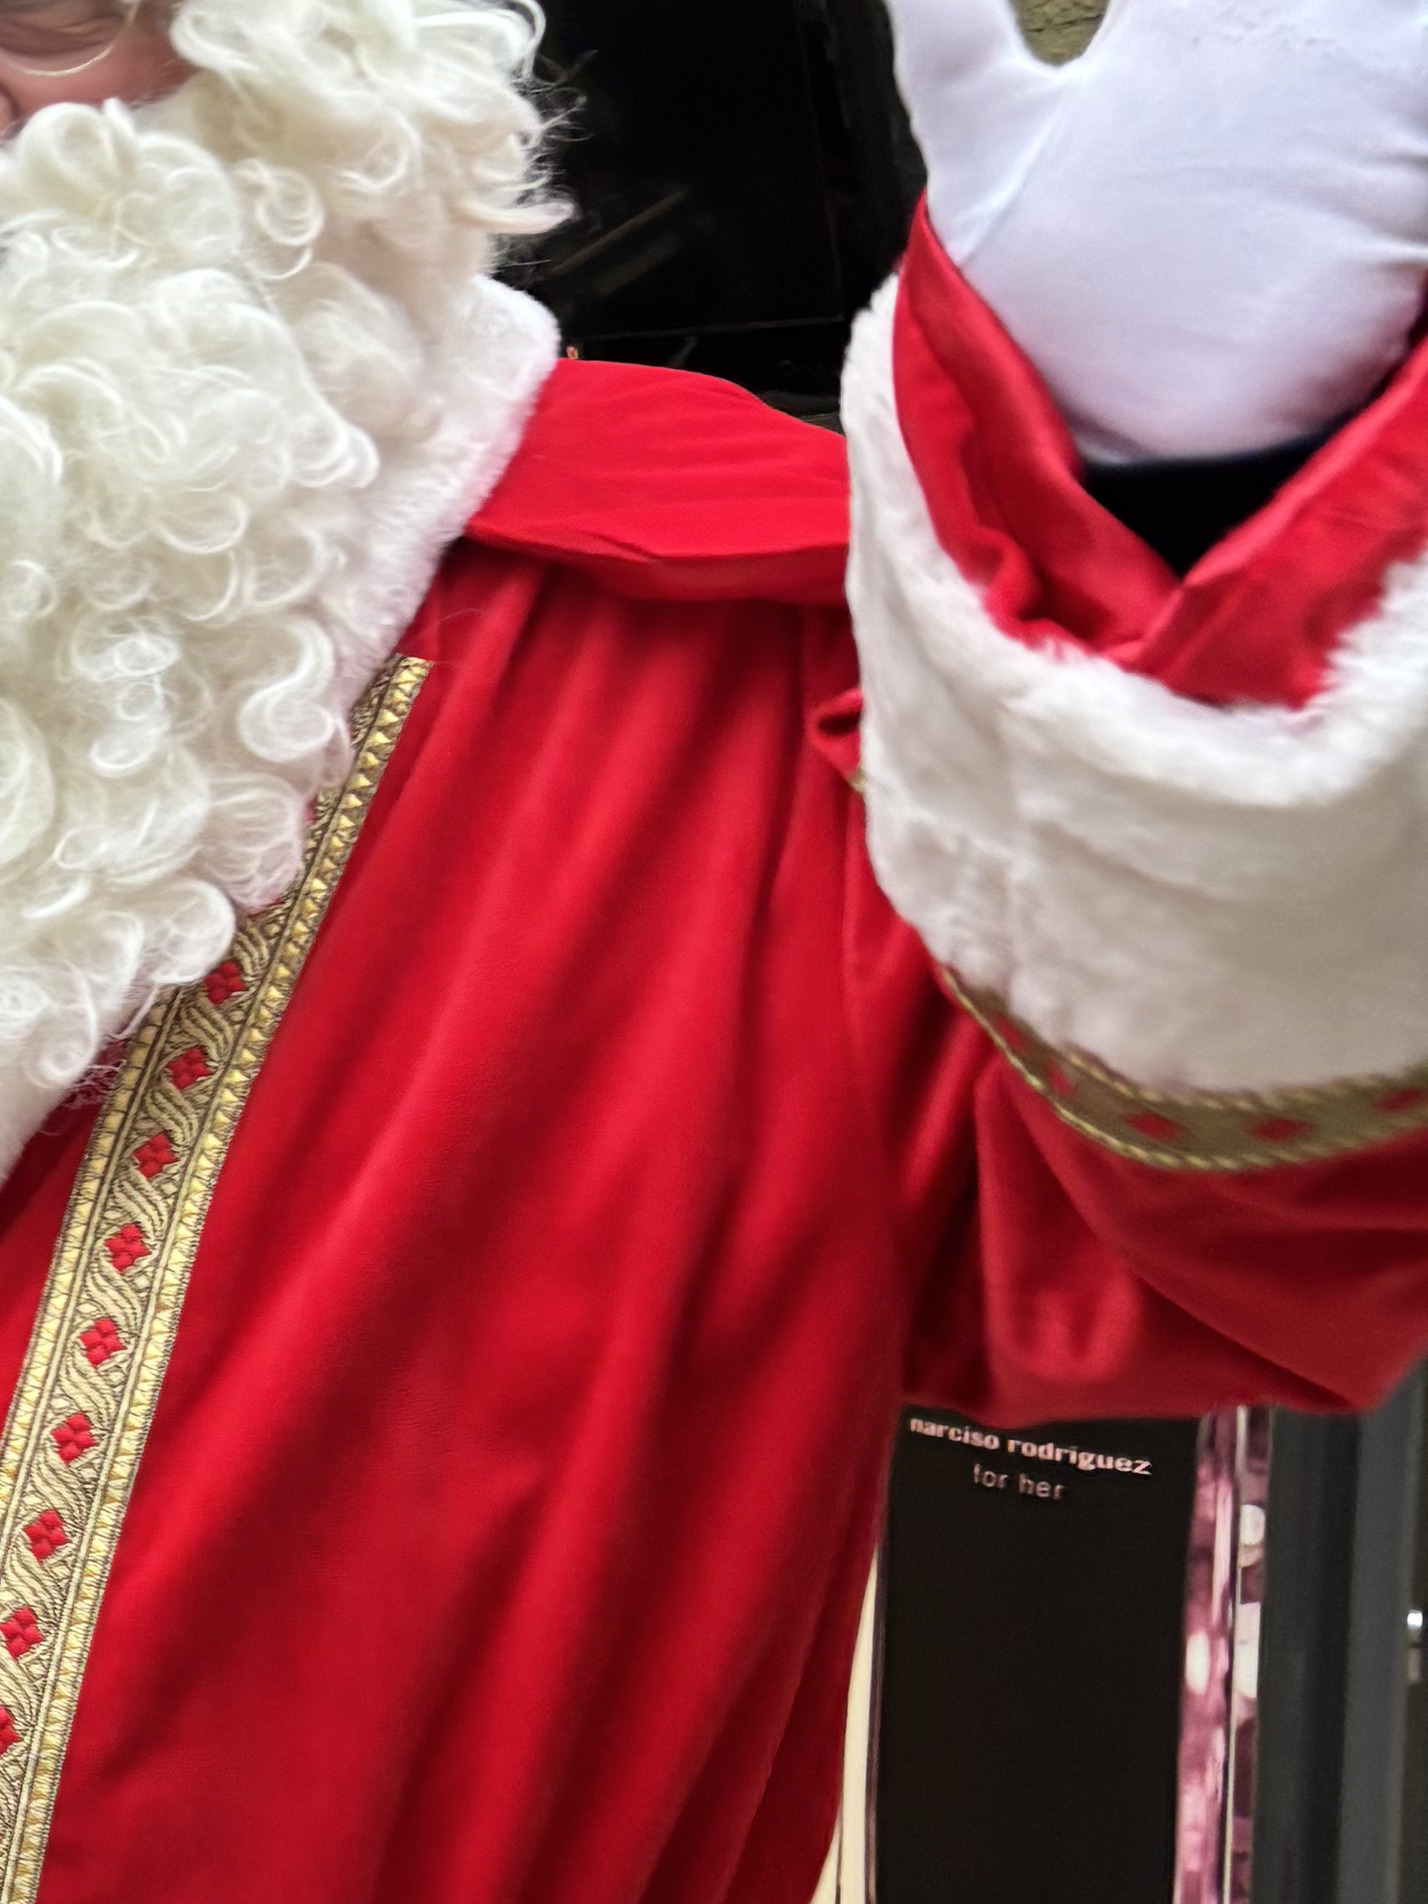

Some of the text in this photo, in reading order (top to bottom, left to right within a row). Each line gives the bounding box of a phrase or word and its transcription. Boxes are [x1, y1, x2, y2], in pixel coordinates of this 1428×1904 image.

[909, 1415, 1153, 1477] narciso rodriguez
[972, 1463, 1066, 1501] for her
